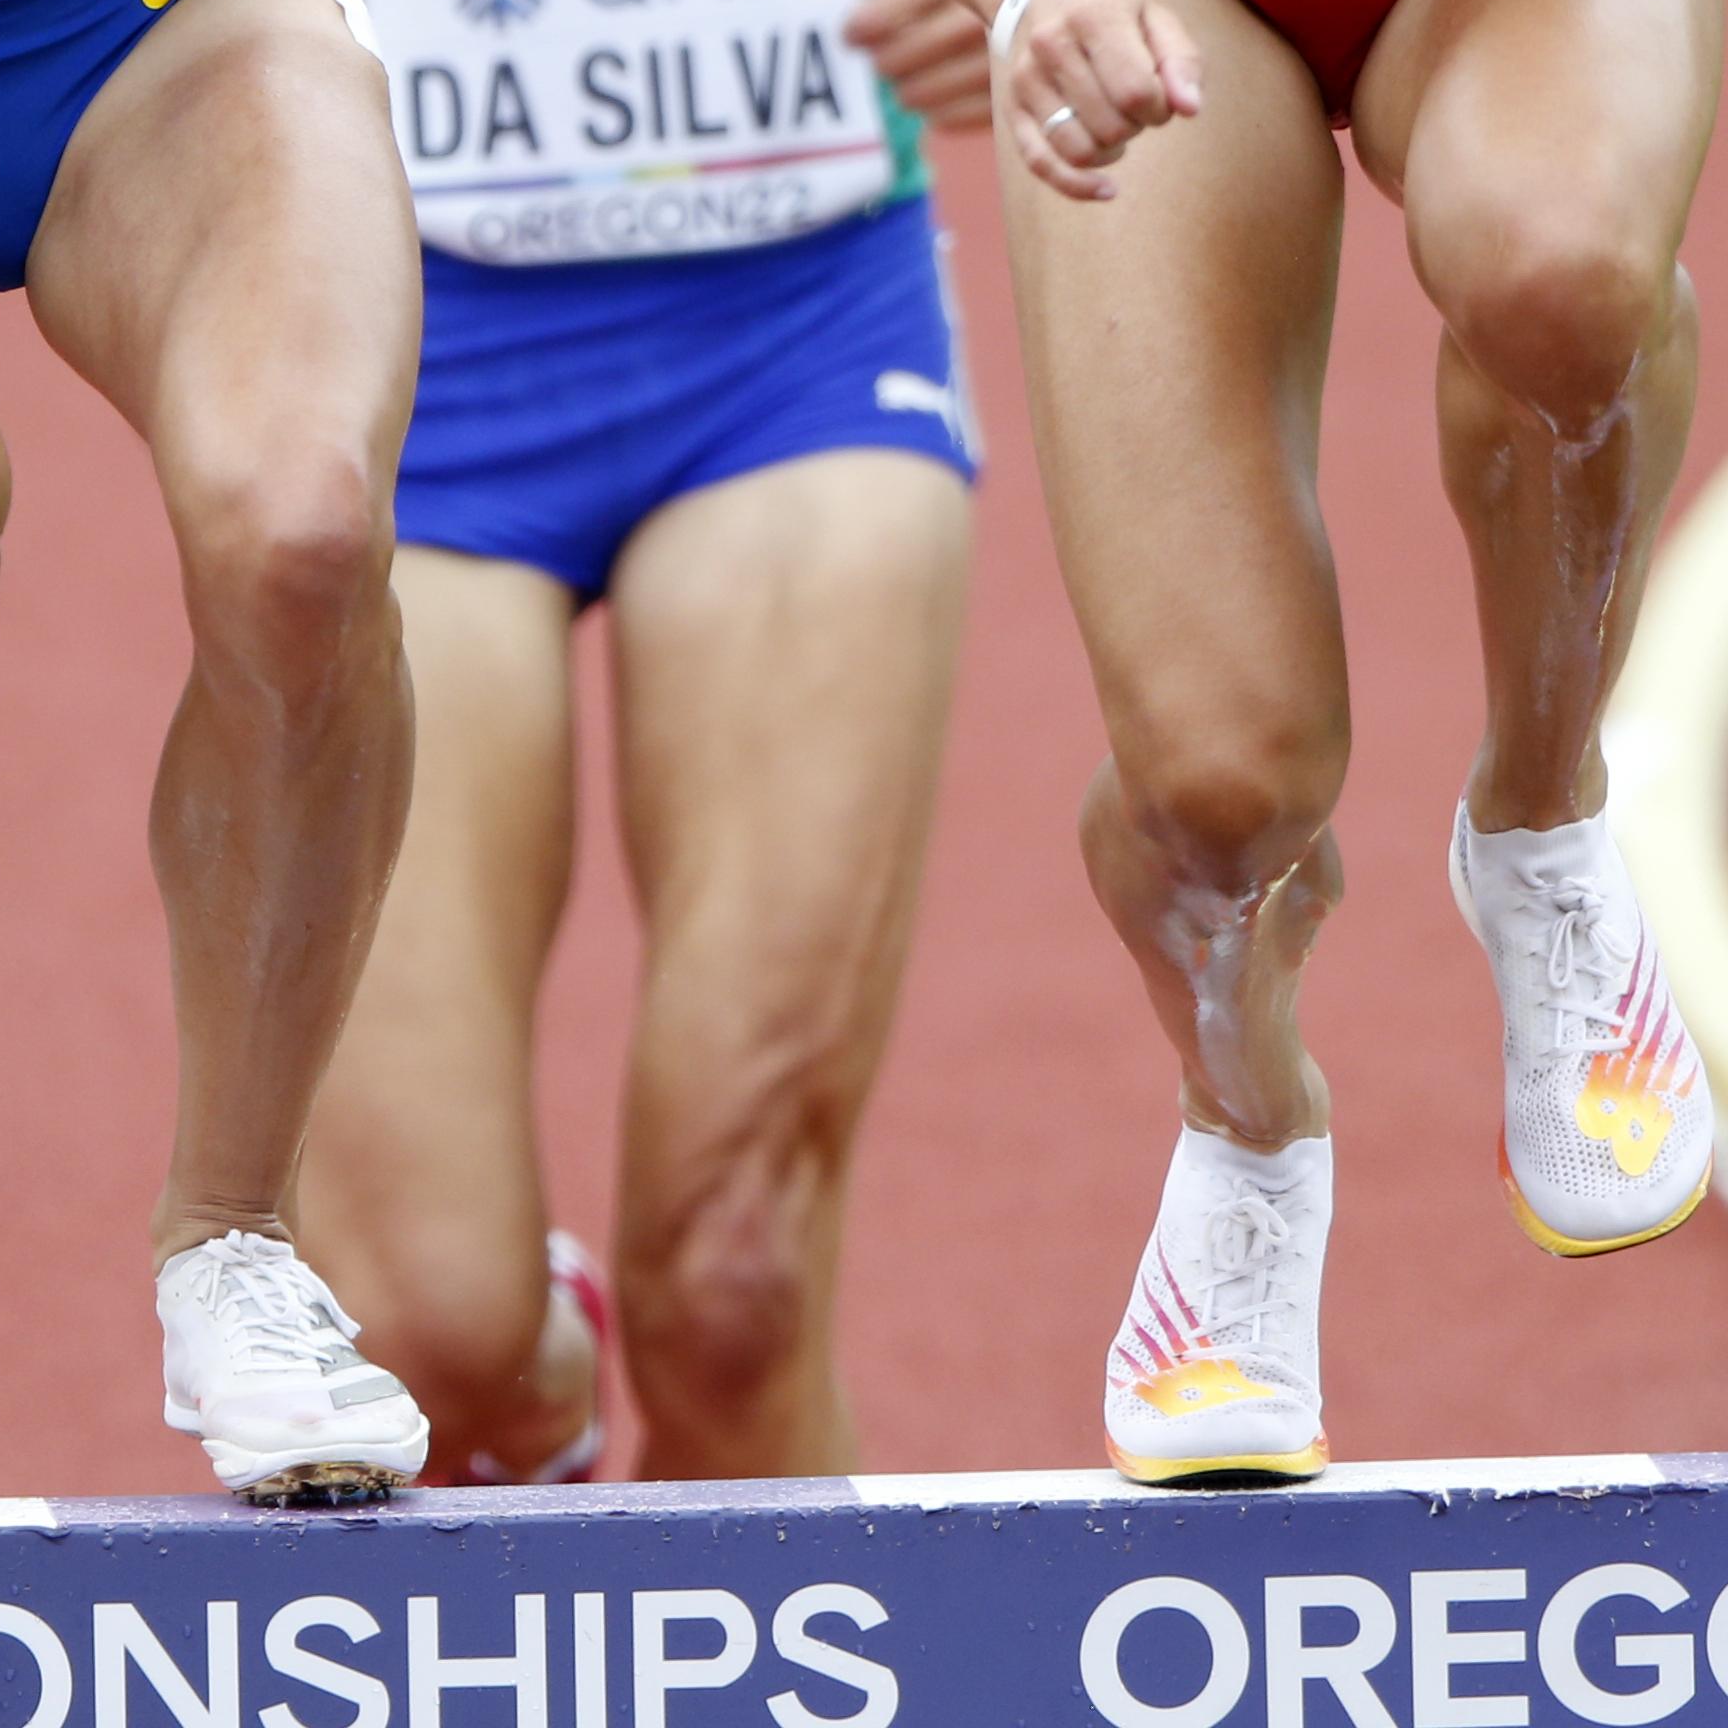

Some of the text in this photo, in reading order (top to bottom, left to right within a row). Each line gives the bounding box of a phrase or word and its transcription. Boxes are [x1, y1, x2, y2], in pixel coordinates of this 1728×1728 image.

[408, 28, 844, 160] DA SILVA
[466, 183, 811, 252] OREGON22
